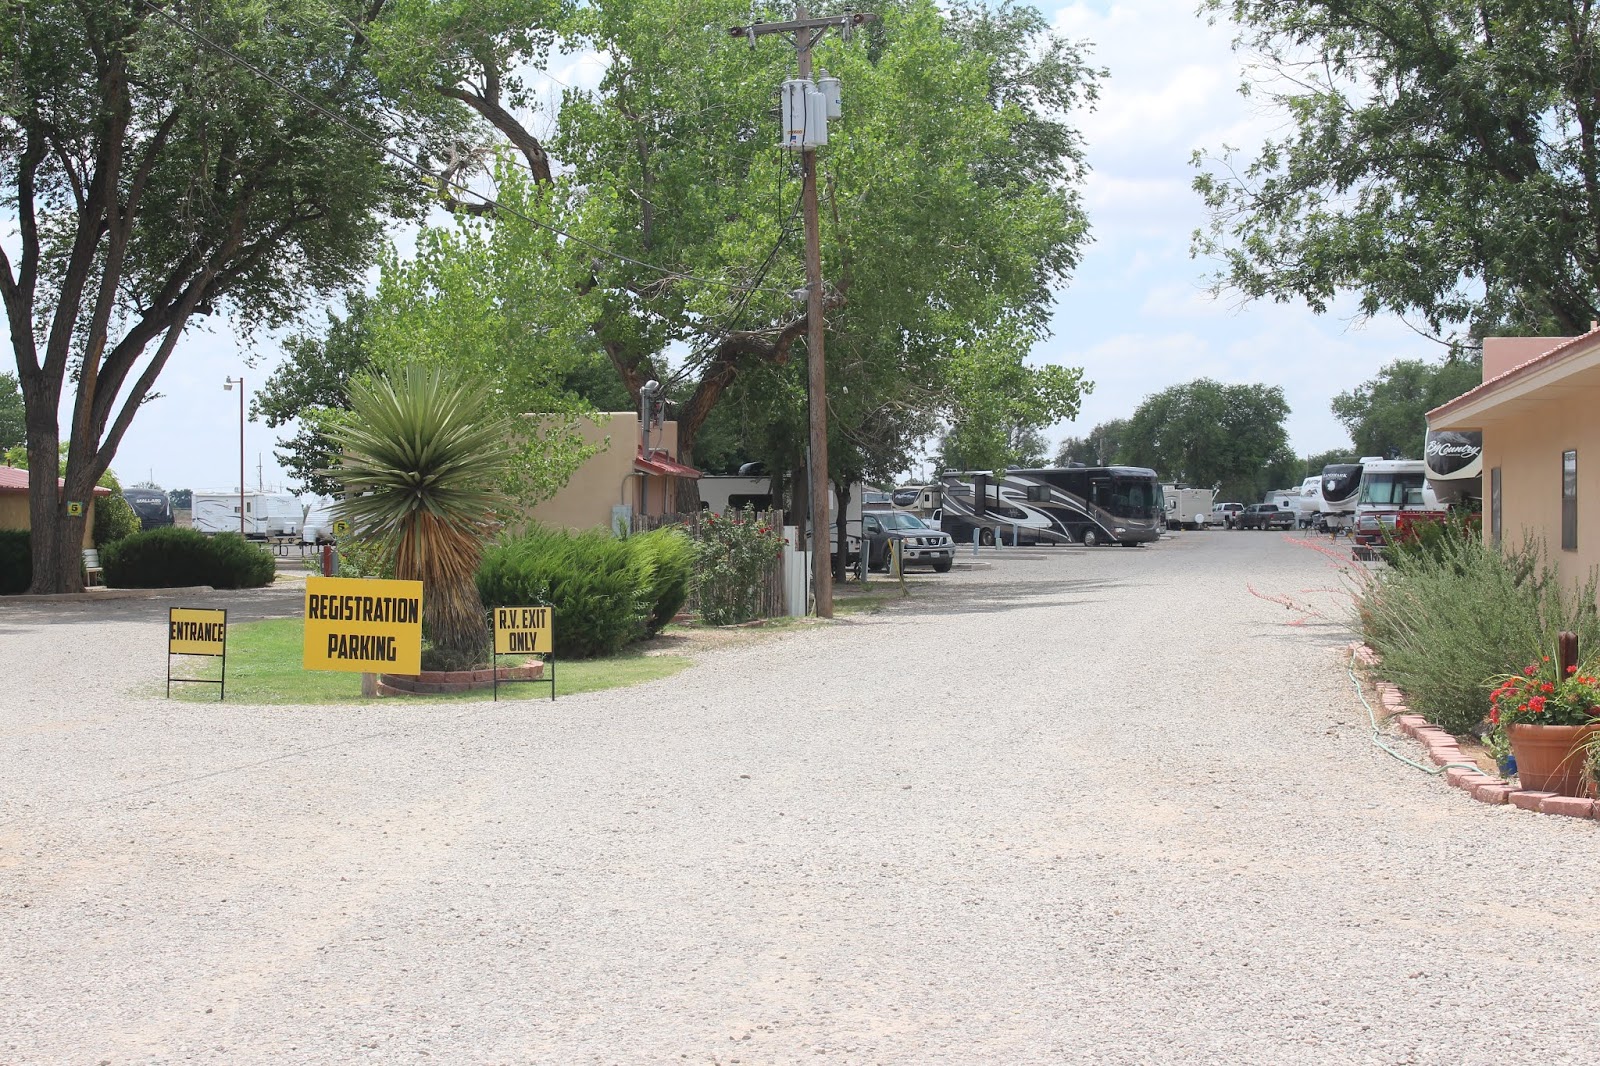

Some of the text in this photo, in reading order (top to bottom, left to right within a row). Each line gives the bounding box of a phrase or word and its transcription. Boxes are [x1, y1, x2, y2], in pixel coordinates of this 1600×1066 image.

[1427, 440, 1481, 459] Big Country
[71, 504, 78, 512] 5
[309, 594, 419, 623] REGISTRATION
[500, 609, 546, 629] R.V. EXIT
[170, 621, 224, 642] ENTRANCE
[509, 631, 537, 651] ONLY
[328, 633, 396, 661] PARKING
